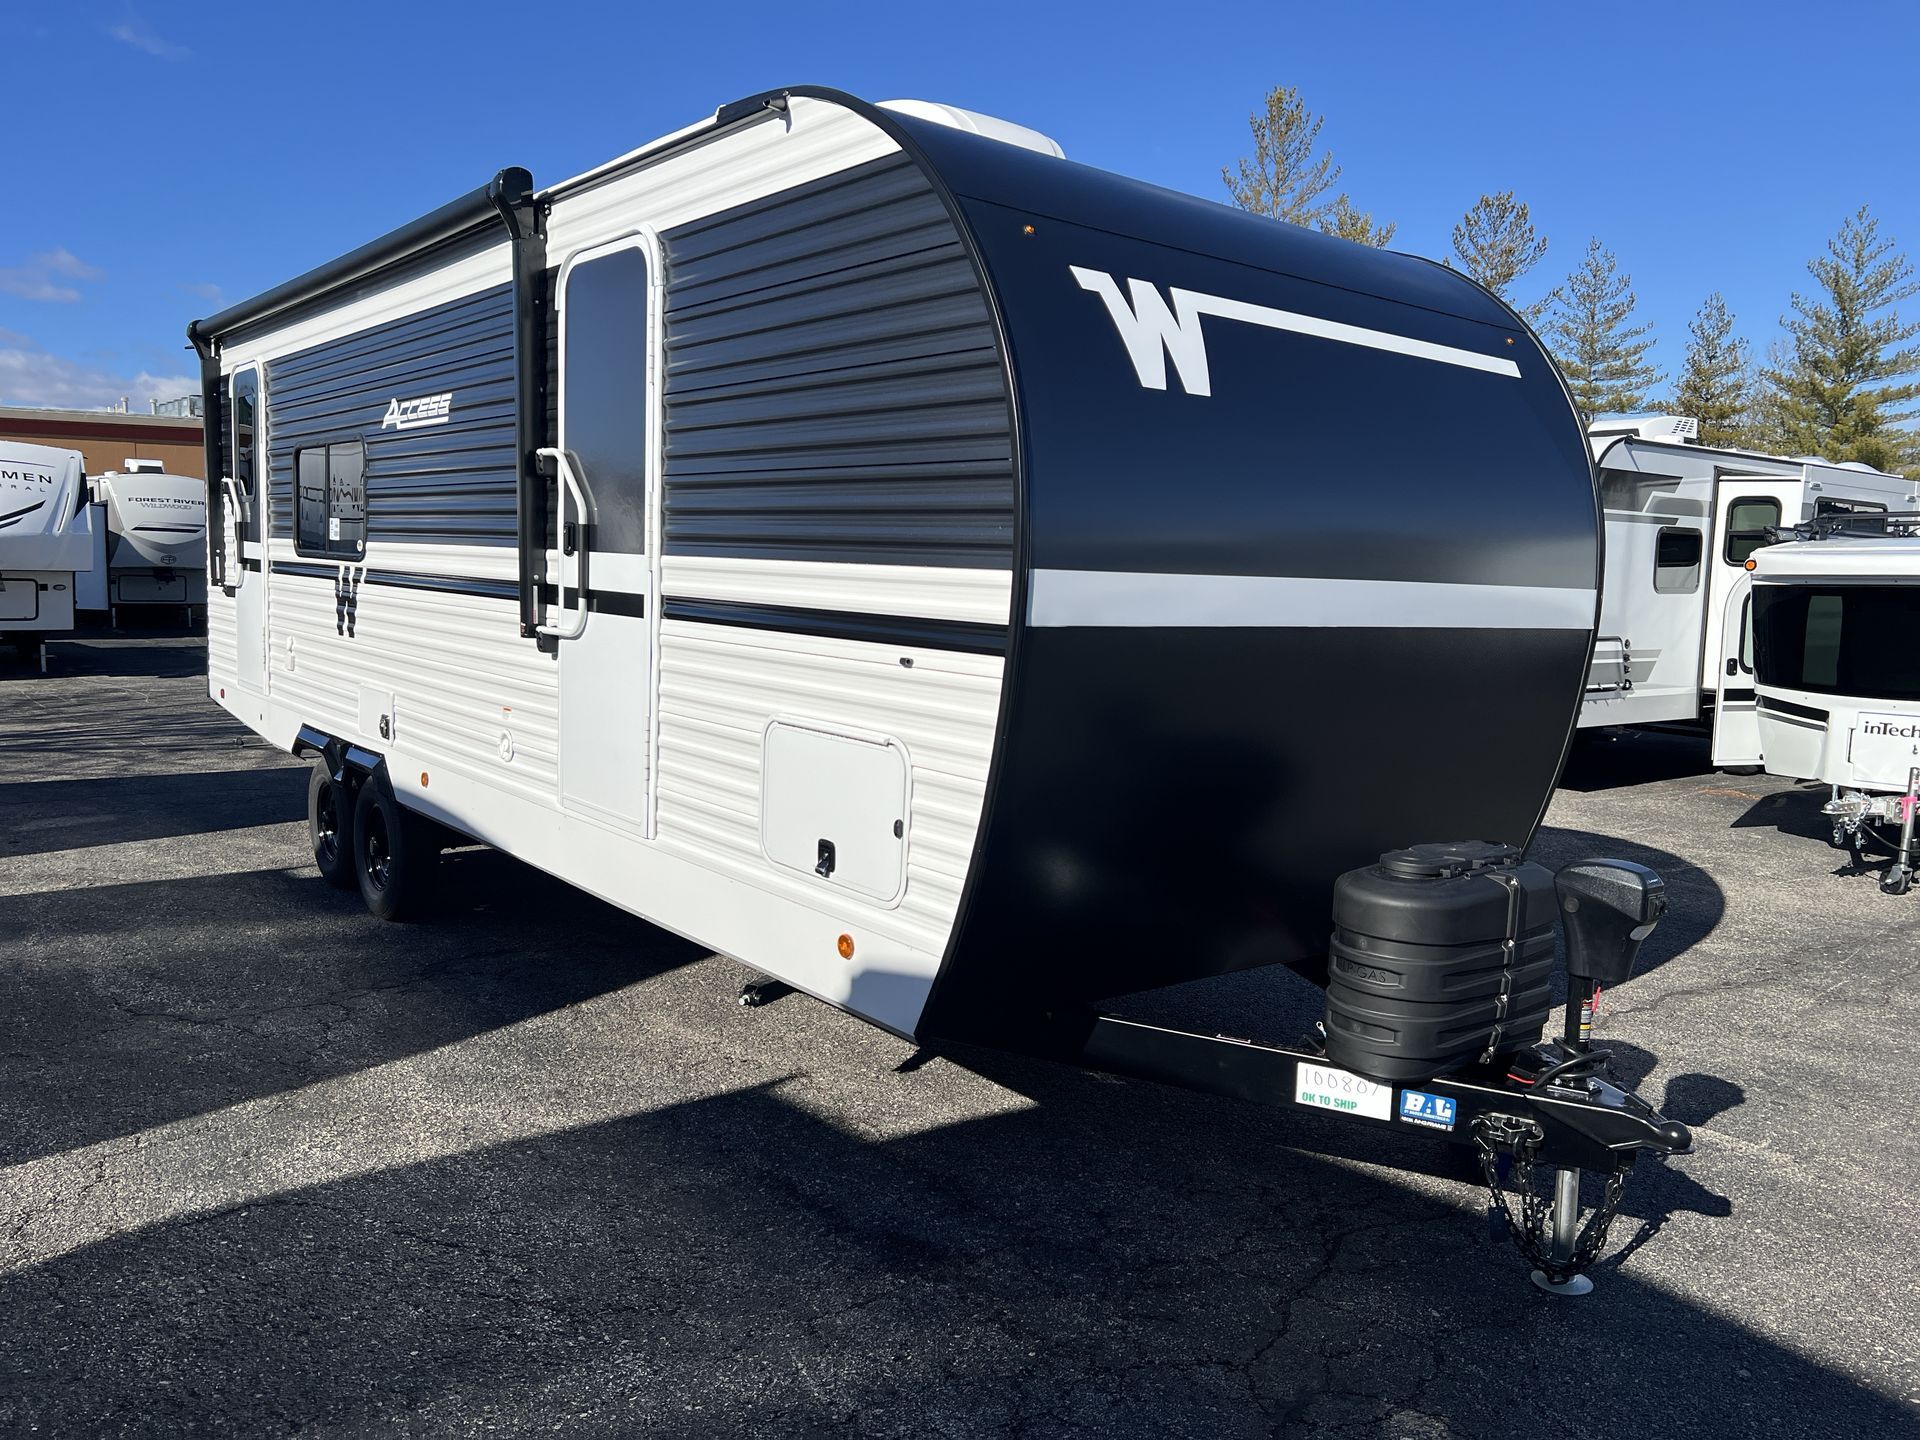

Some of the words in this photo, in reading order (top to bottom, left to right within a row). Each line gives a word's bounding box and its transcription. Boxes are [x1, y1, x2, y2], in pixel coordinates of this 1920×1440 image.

[381, 393, 453, 430] ACCESS
[1, 470, 52, 484] MEN
[140, 502, 192, 510] WILDWOOD
[173, 498, 205, 506] RIVER
[1864, 721, 1920, 738] inTech
[1357, 966, 1386, 983] GAS
[1302, 1091, 1316, 1103] OK
[1318, 1094, 1332, 1106] TO
[1334, 1098, 1358, 1111] SHIP
[1404, 1092, 1452, 1118] BAL
